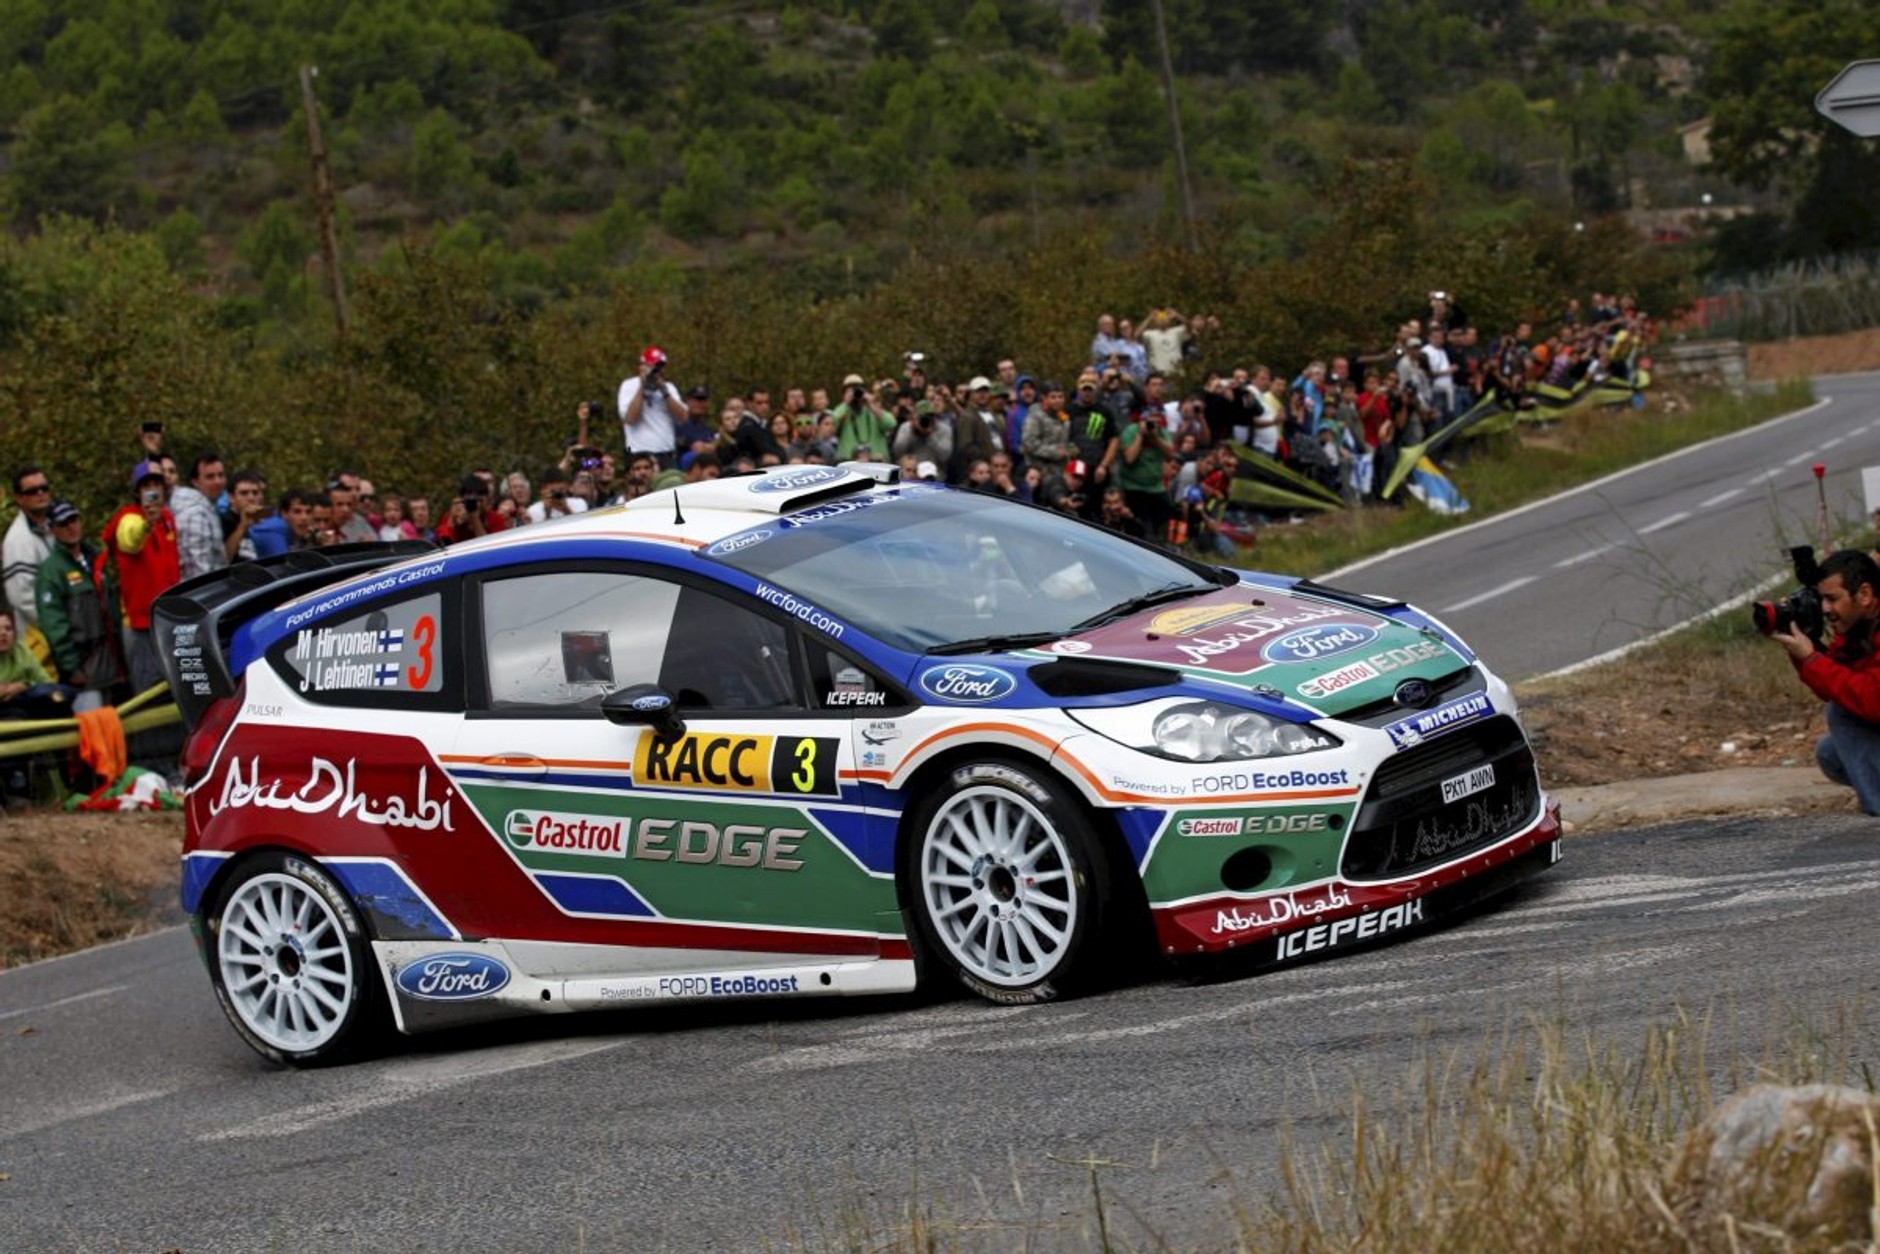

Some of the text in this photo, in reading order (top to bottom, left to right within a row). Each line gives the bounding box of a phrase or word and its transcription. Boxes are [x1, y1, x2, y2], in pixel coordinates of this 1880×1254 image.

[769, 470, 836, 489] Ford
[721, 532, 765, 552] Ford
[286, 561, 445, 629] Ford recommends Castrol
[755, 583, 844, 639] wrcford.com
[296, 628, 378, 660] M Hirvonen
[408, 614, 436, 690] 3
[1281, 627, 1365, 658] Ford
[300, 659, 374, 693] J Lehtinen
[935, 667, 999, 698] Ford
[1318, 640, 1447, 692] Castrol EDGE
[246, 703, 284, 717] PULSAR
[826, 691, 886, 705] ICEPEAK
[1418, 695, 1490, 732] MICHELIN
[646, 734, 818, 792] RACC 3
[1113, 769, 1349, 796] Powered by FORD EcoBoost
[1444, 767, 1494, 800] PX11 AWN
[1193, 813, 1328, 835] Castrol EDGE
[535, 815, 809, 871] Castrol EDGE
[1276, 897, 1424, 961] ICEPEAK
[418, 960, 490, 993] Ford
[601, 975, 799, 998] Powered by FORD EcoBoost
